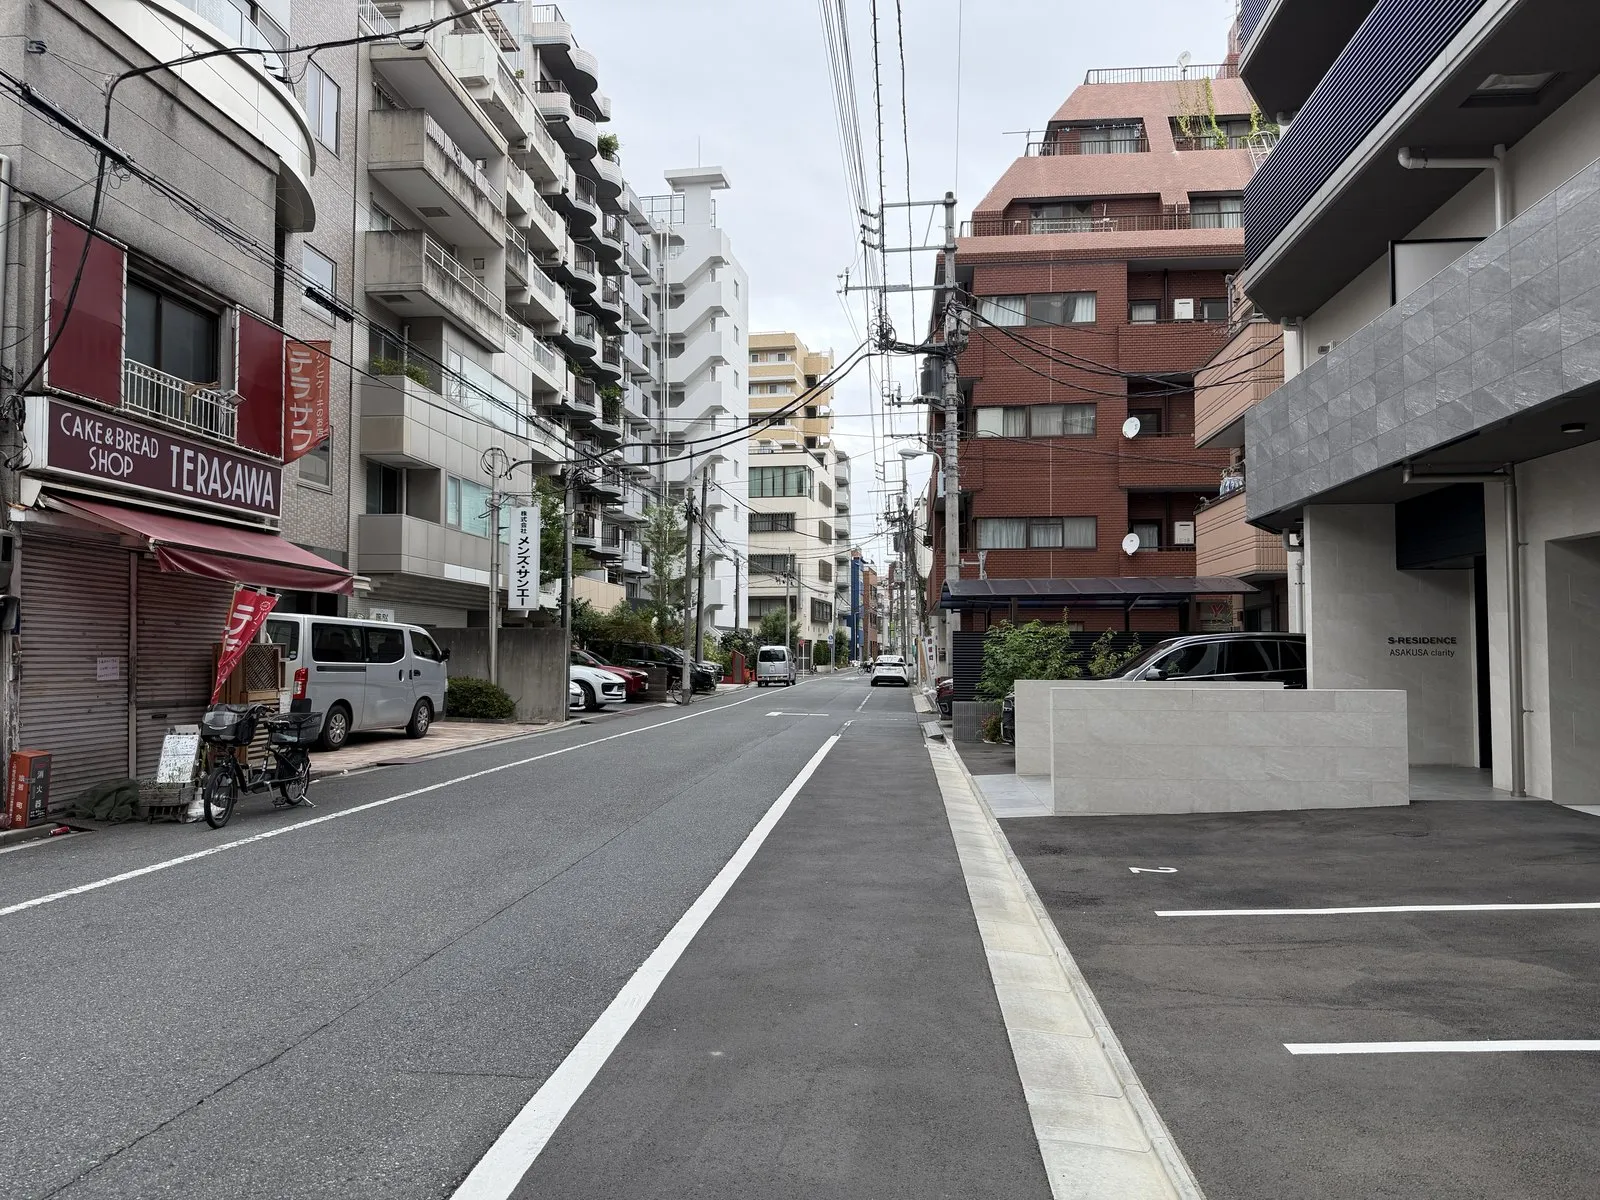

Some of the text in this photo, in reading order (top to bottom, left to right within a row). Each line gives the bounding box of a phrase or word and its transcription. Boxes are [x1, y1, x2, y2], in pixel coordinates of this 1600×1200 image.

[290, 351, 313, 451] テラサワ
[89, 446, 134, 478] SHOP
[170, 444, 275, 510] TERASAWA
[520, 510, 528, 534] 株式会社
[1387, 636, 1457, 645] S-RESIDENCE
[1389, 648, 1455, 658] ASAKUSA clarity
